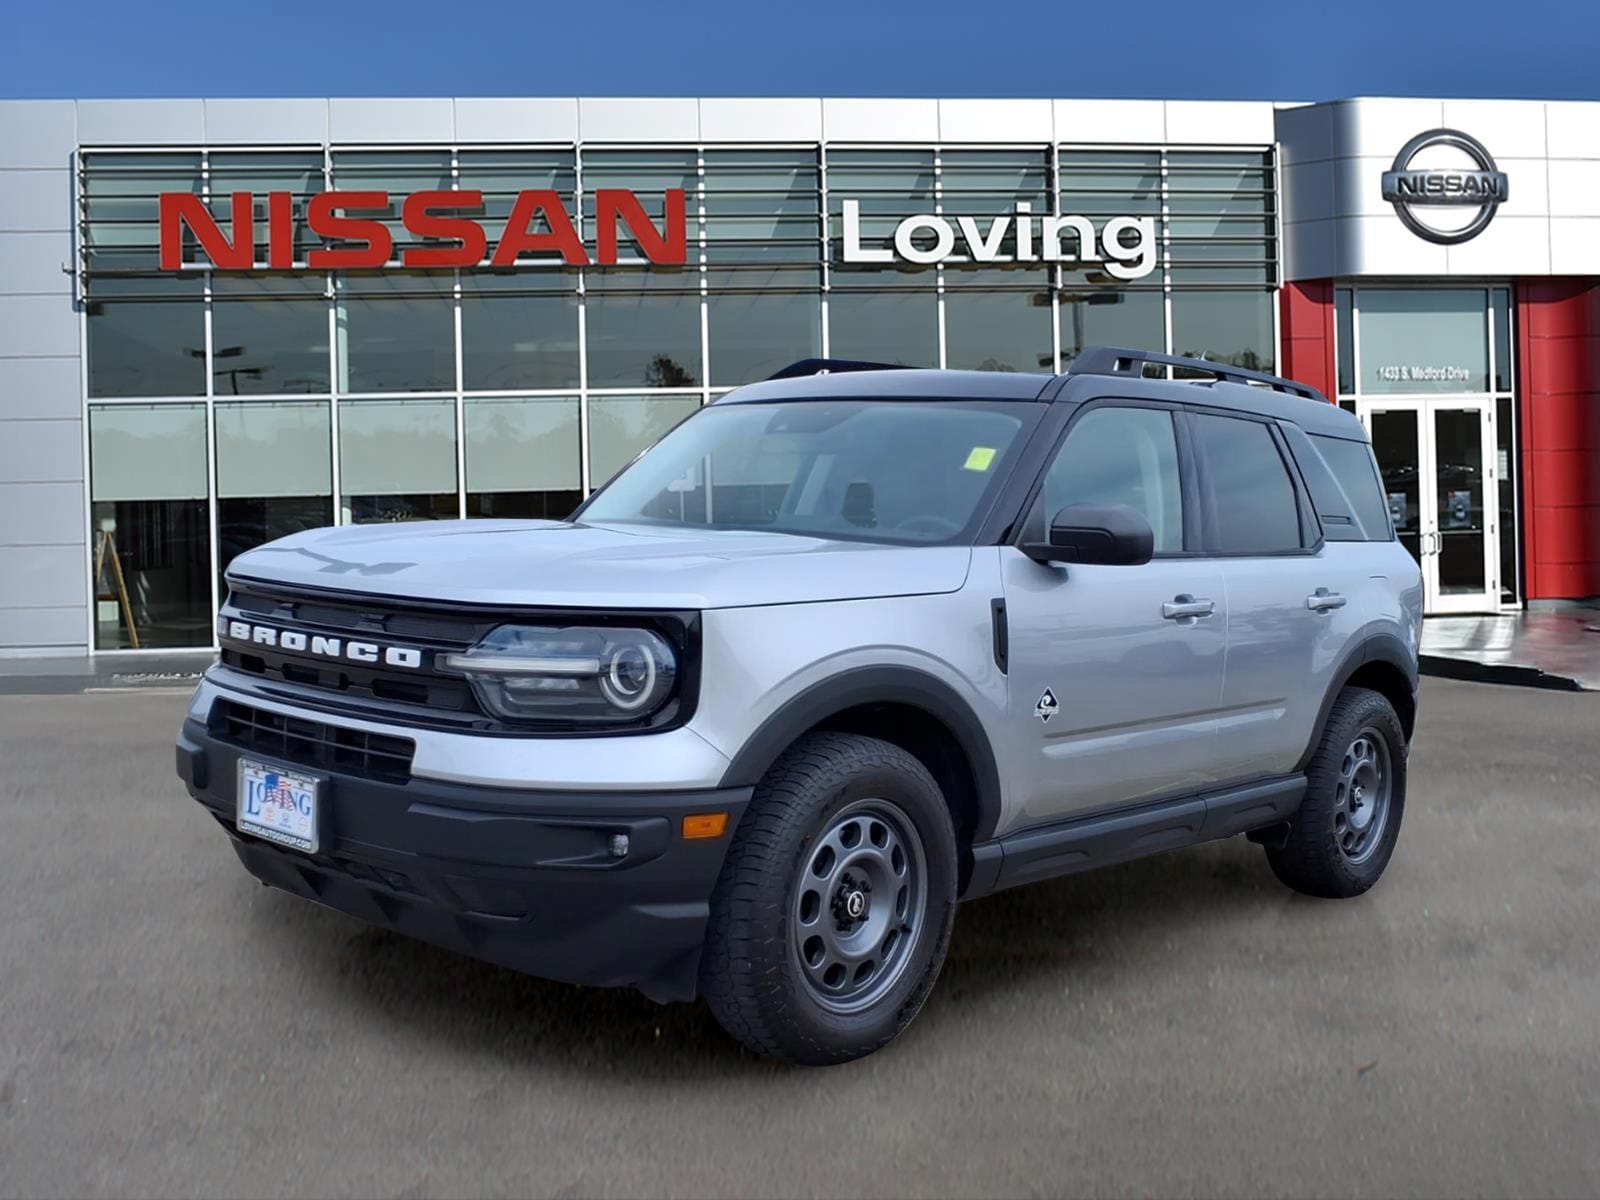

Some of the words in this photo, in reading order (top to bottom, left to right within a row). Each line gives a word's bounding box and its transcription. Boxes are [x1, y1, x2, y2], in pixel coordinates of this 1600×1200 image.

[1396, 175, 1499, 195] NISSAN
[158, 188, 687, 271] NISSAN
[842, 199, 1157, 279] Loving
[1447, 366, 1470, 380] Drive
[229, 621, 421, 668] BRONCO
[247, 780, 311, 816] LOVING
